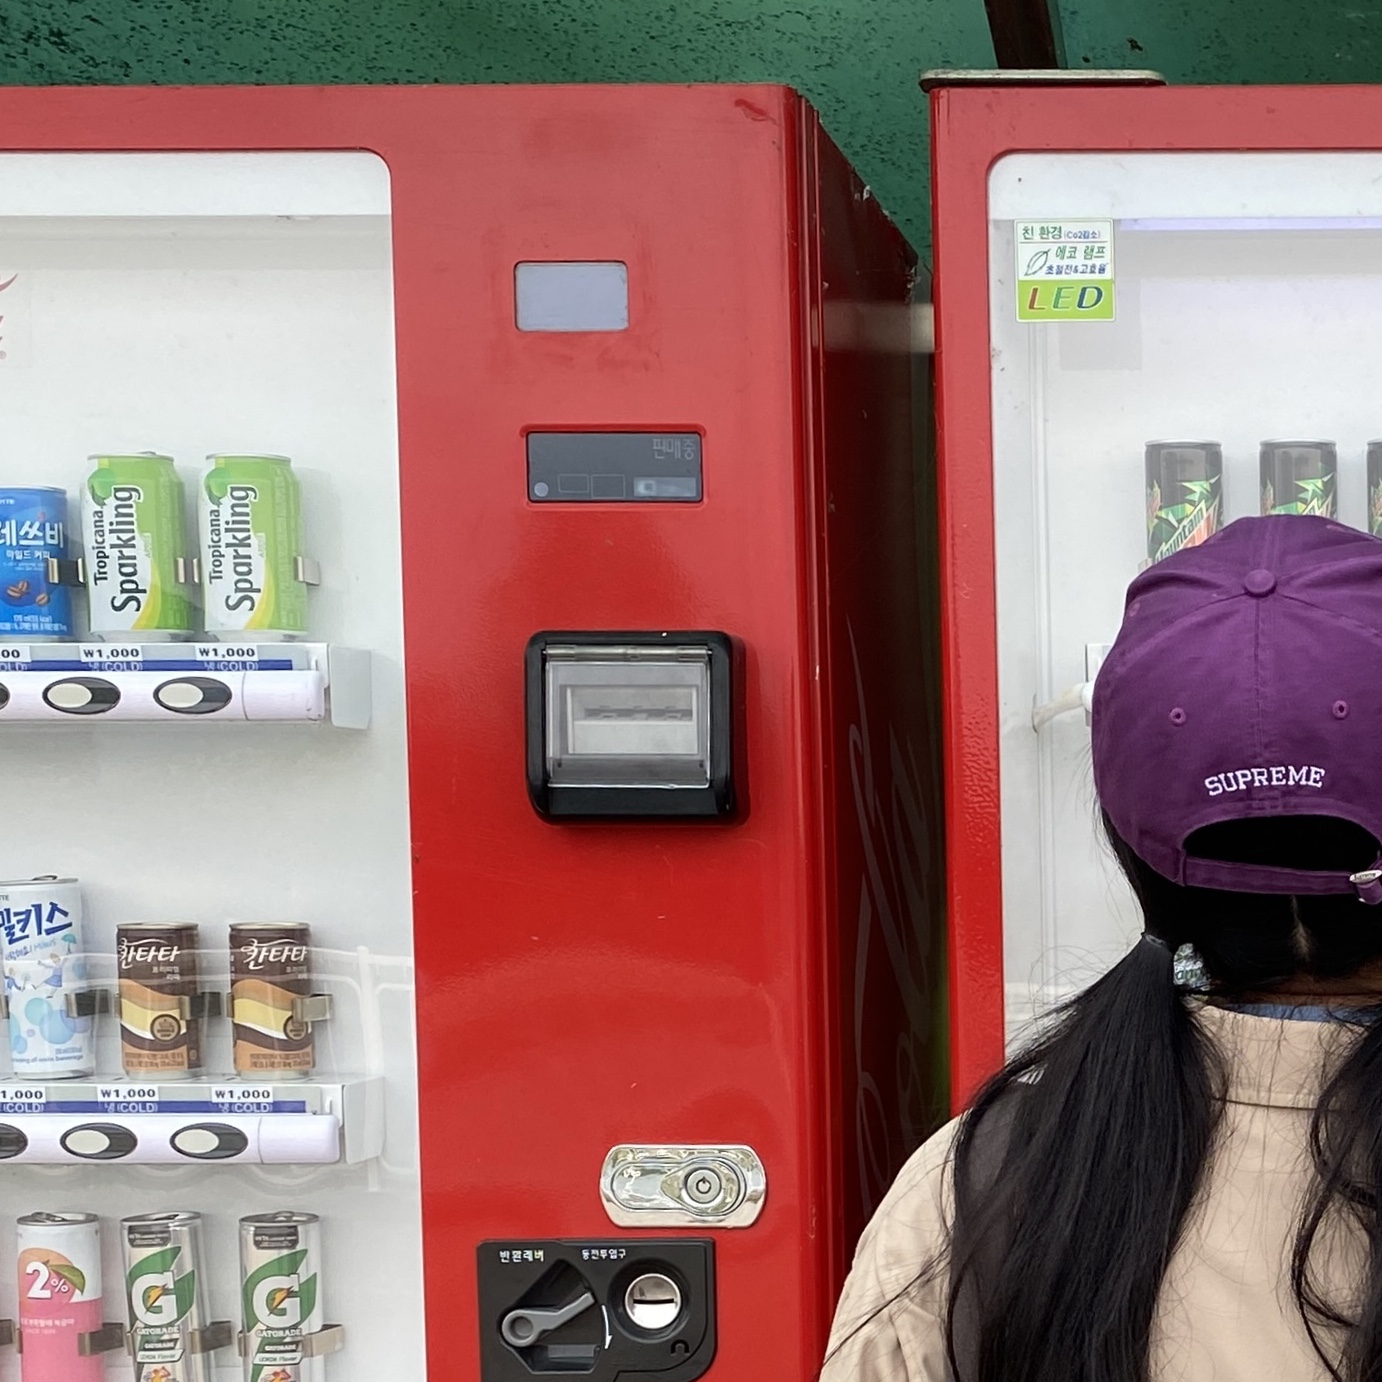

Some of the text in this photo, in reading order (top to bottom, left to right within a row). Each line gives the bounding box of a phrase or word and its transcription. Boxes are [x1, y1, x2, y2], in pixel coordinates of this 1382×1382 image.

[1022, 226, 1034, 240] 친
[1038, 226, 1062, 240] 환경
[1055, 245, 1106, 260] 에코 램프
[1028, 286, 1104, 311] LED
[652, 438, 695, 460] 판매중
[91, 507, 110, 585] Tropicana
[110, 486, 147, 612] Sparkling
[208, 507, 225, 584] Tropicana
[225, 486, 262, 612] Sparkling
[83, 648, 140, 660] ₩1,000
[199, 647, 256, 659] ₩1,000
[1204, 765, 1325, 796] SUPREME
[0, 901, 73, 945] 밀키스
[118, 937, 181, 969] 칸타타
[241, 938, 307, 970] 칸타타
[100, 1088, 156, 1100] ₩1,000
[215, 1088, 271, 1101] ₩1,000
[499, 1249, 545, 1263] 반환레버
[582, 1248, 627, 1260] 동전투입구
[26, 1262, 69, 1299] 2%
[131, 1269, 178, 1325] G
[253, 1273, 300, 1327] G
[136, 1326, 179, 1336] GATORADE
[255, 1327, 302, 1337] GATORADE
